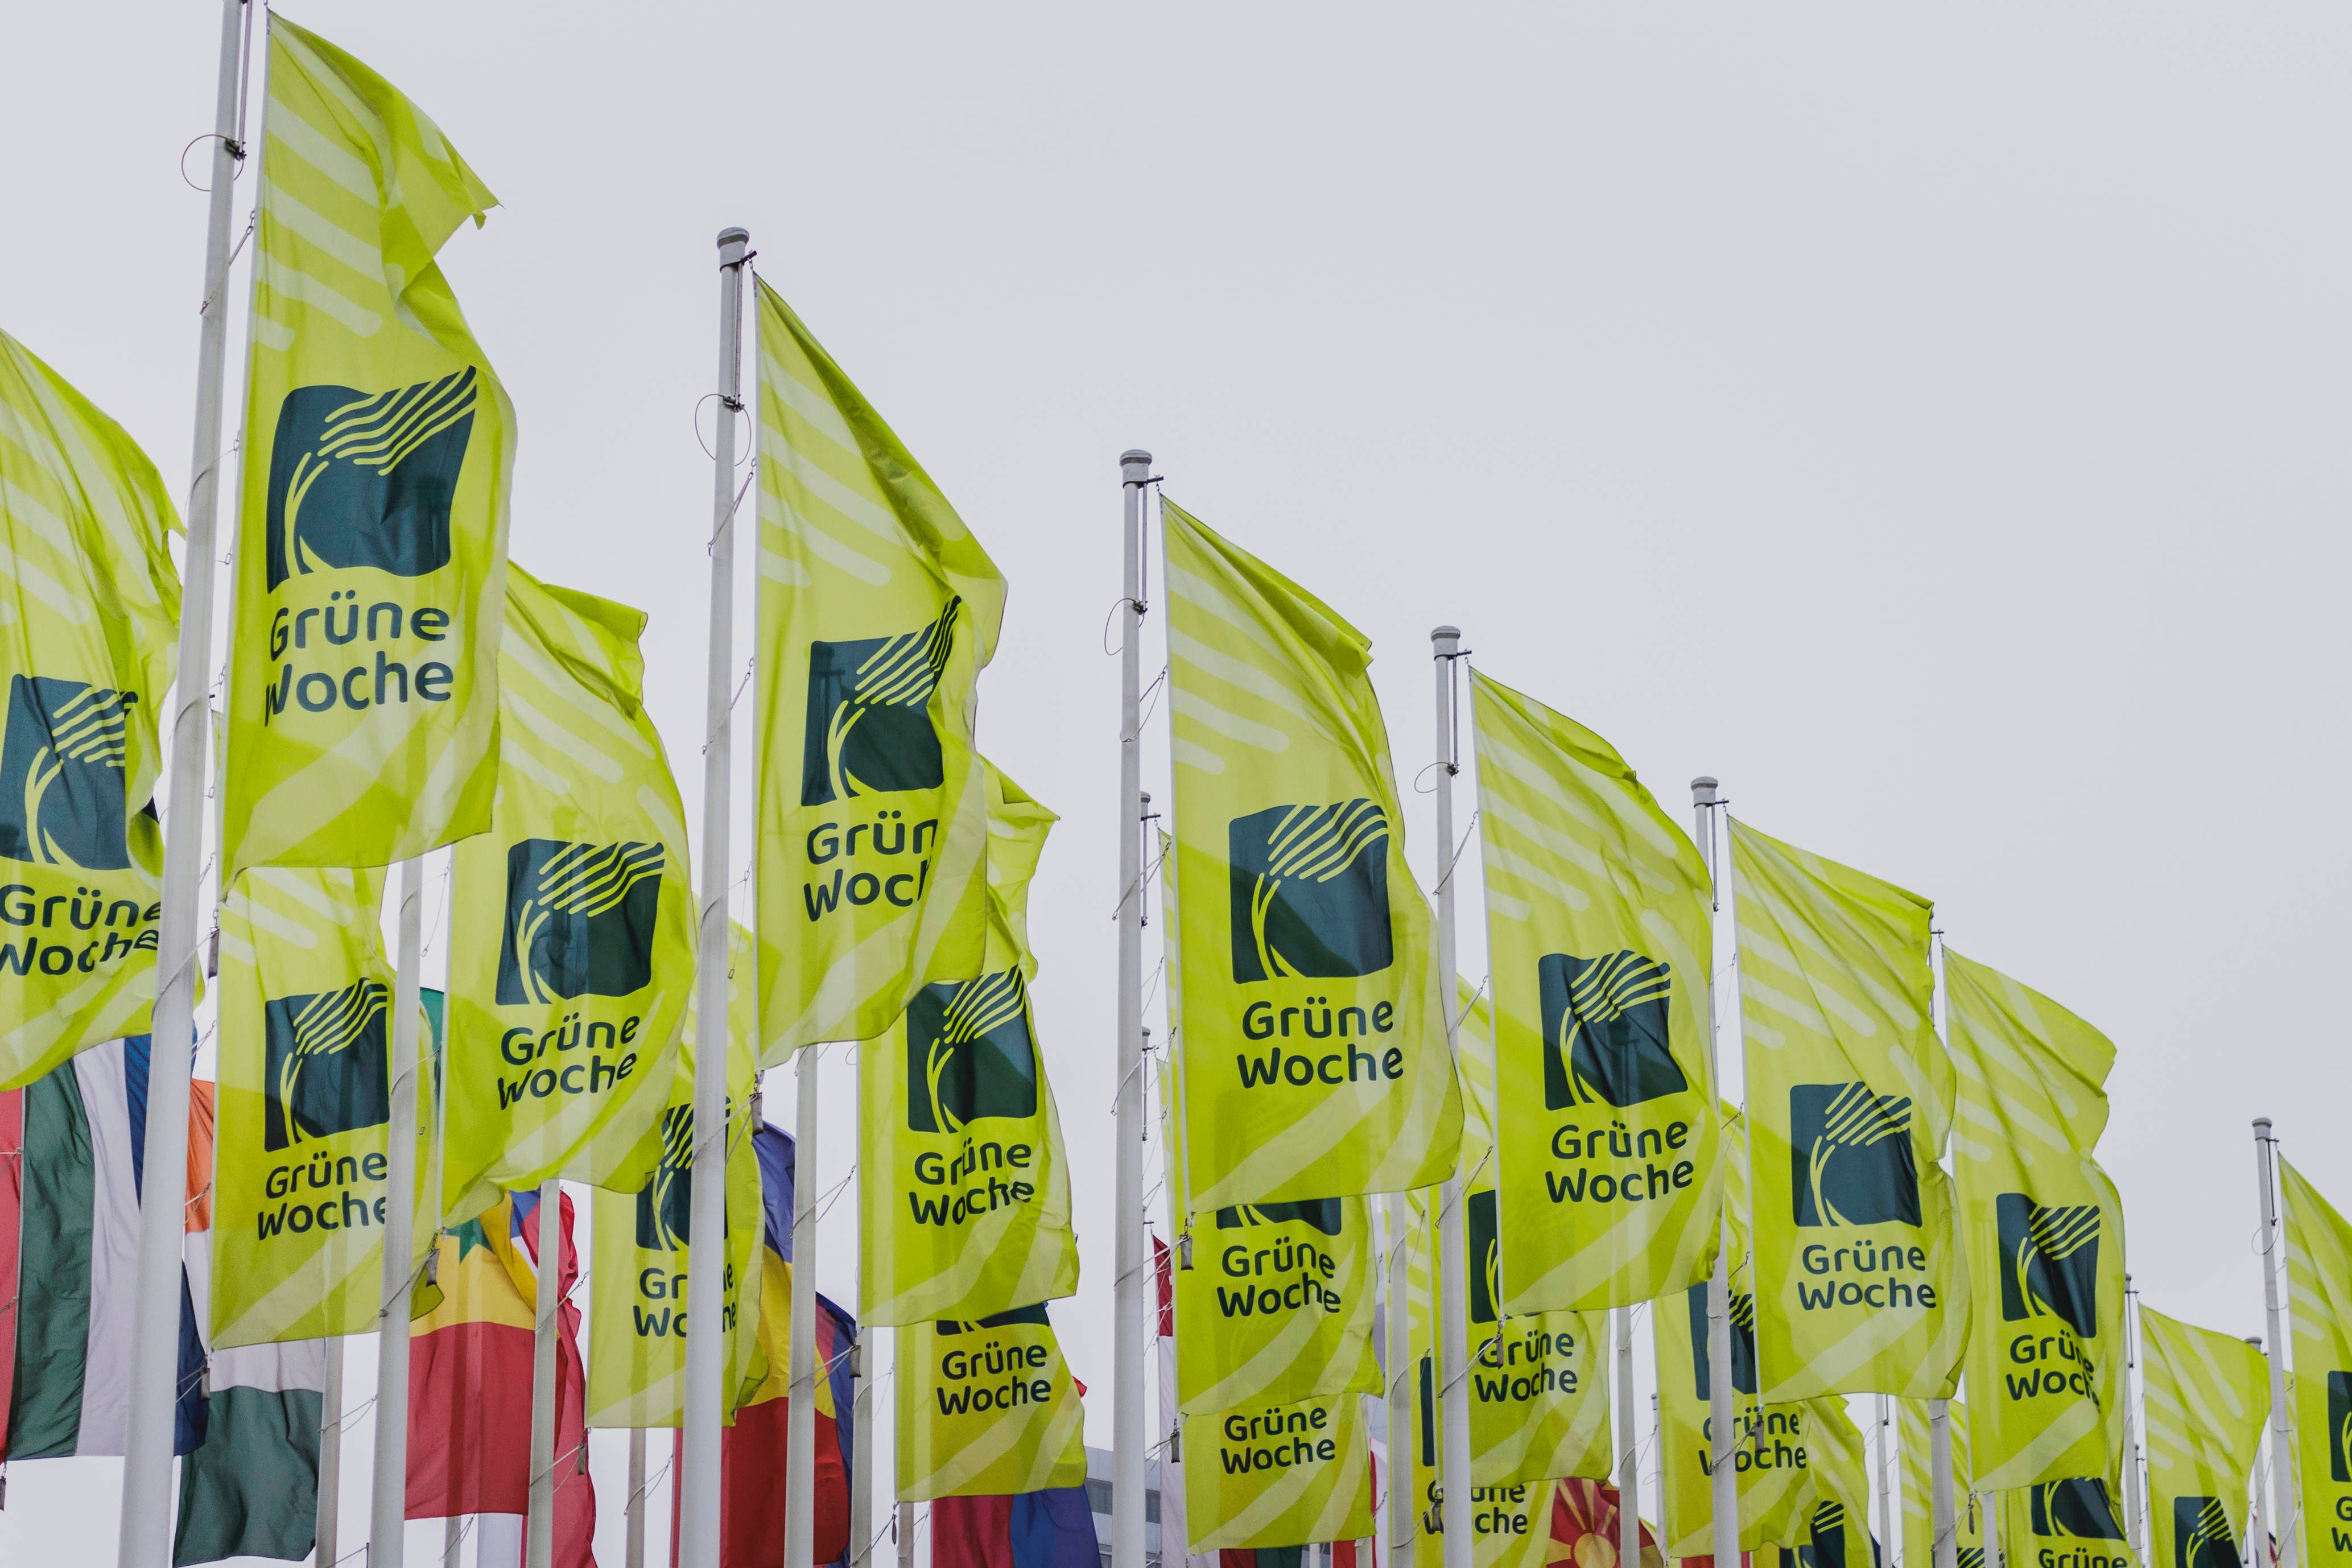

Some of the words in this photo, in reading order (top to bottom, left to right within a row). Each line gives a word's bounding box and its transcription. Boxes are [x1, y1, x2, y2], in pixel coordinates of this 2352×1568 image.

[270, 589, 449, 662] Grüne
[265, 651, 453, 727] Woche
[807, 810, 938, 865] Grün
[0, 884, 160, 930] Grüne
[501, 1012, 639, 1066] Grüne
[1243, 996, 1393, 1040] Grüne
[497, 1053, 637, 1111] Woche
[1236, 1043, 1404, 1088] Woche
[914, 1137, 1031, 1185] Grüne
[1552, 1120, 1688, 1159] Grüne
[266, 1151, 387, 1199] Grüne
[1545, 1161, 1694, 1203] Woche
[909, 1177, 1034, 1226] Woche
[1222, 1236, 1335, 1279] Grüne
[1802, 1240, 1925, 1274] Grüne
[639, 1263, 733, 1299] Gre
[1216, 1272, 1341, 1318] Woche
[1798, 1277, 1937, 1310] Woche
[942, 1341, 1047, 1380] Grüne
[1478, 1330, 1574, 1368] Grüne
[937, 1376, 1051, 1416] Woche
[1474, 1362, 1578, 1402] Woche
[1224, 1407, 1327, 1442] Grüne
[1220, 1437, 1335, 1474] Woche
